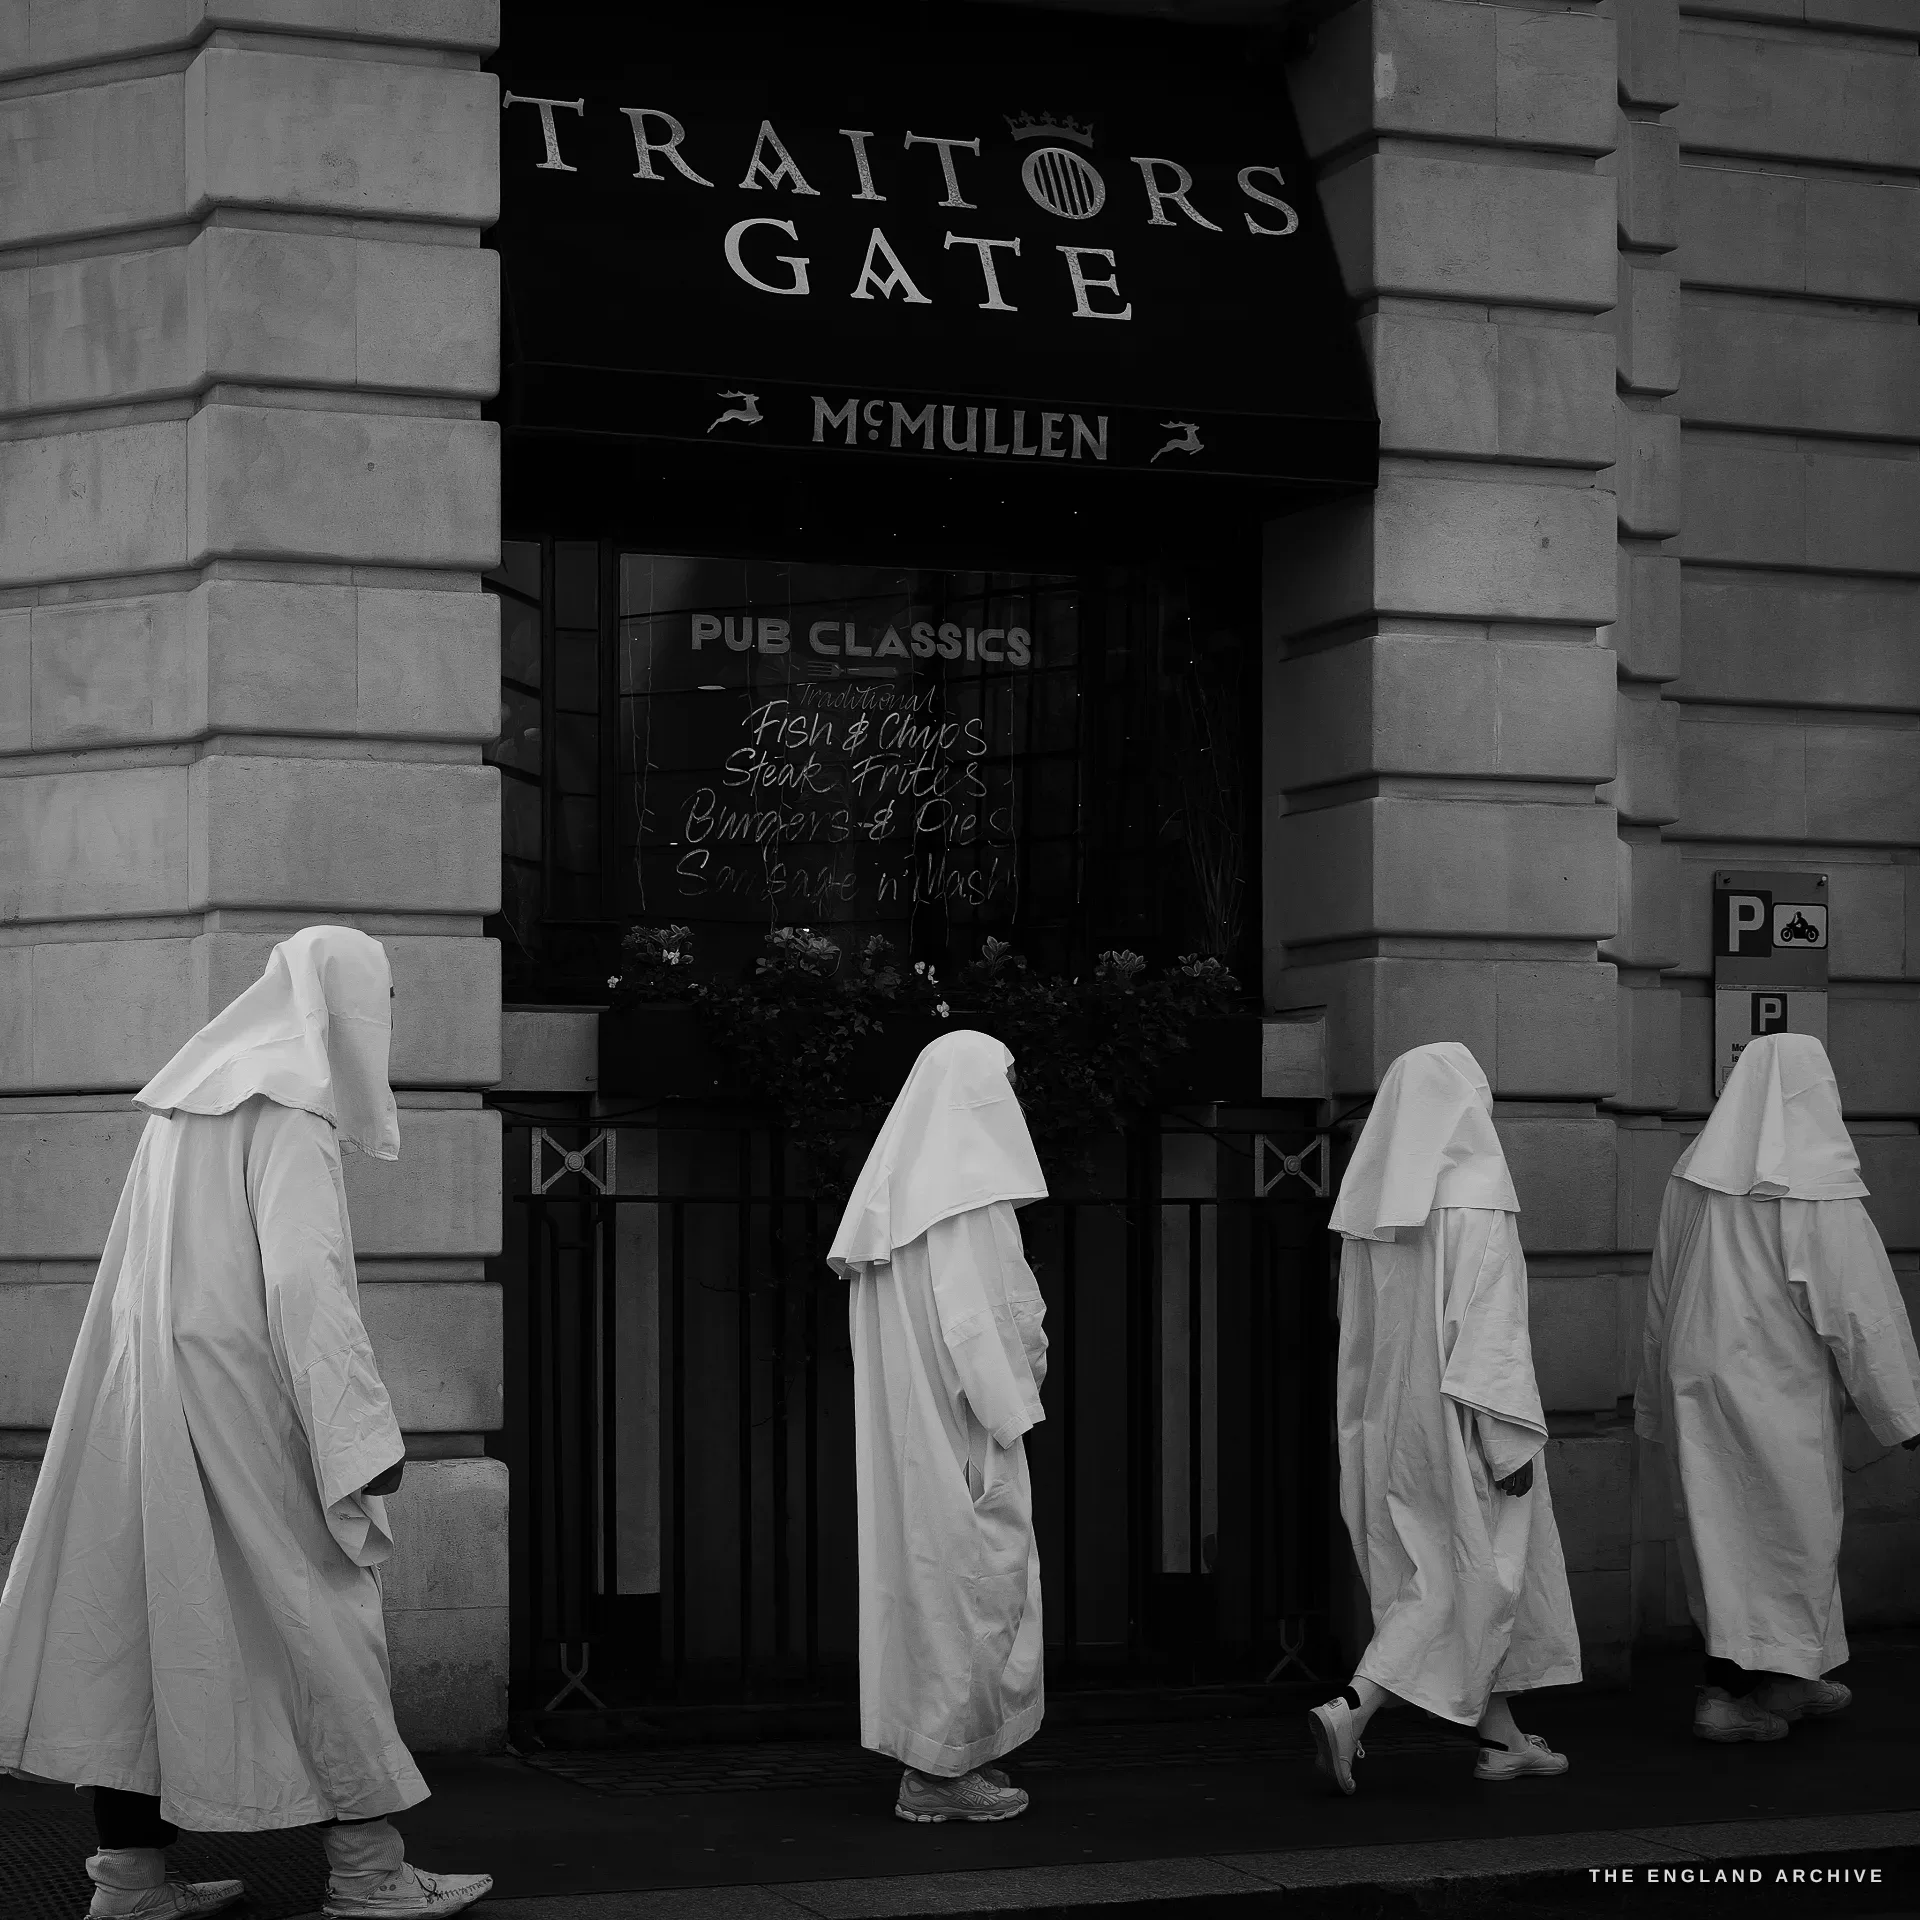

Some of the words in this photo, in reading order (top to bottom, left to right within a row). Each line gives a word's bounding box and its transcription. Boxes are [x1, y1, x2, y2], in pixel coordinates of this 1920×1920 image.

[504, 90, 1299, 236] TRAITORS
[724, 218, 1133, 321] GATE
[691, 613, 792, 655] PUB
[808, 620, 1033, 667] CLASSICS
[797, 682, 936, 713] Traditional
[741, 699, 833, 750] Fish
[722, 747, 841, 797] Steak
[1728, 895, 1765, 953] P
[1759, 997, 1782, 1032] P
